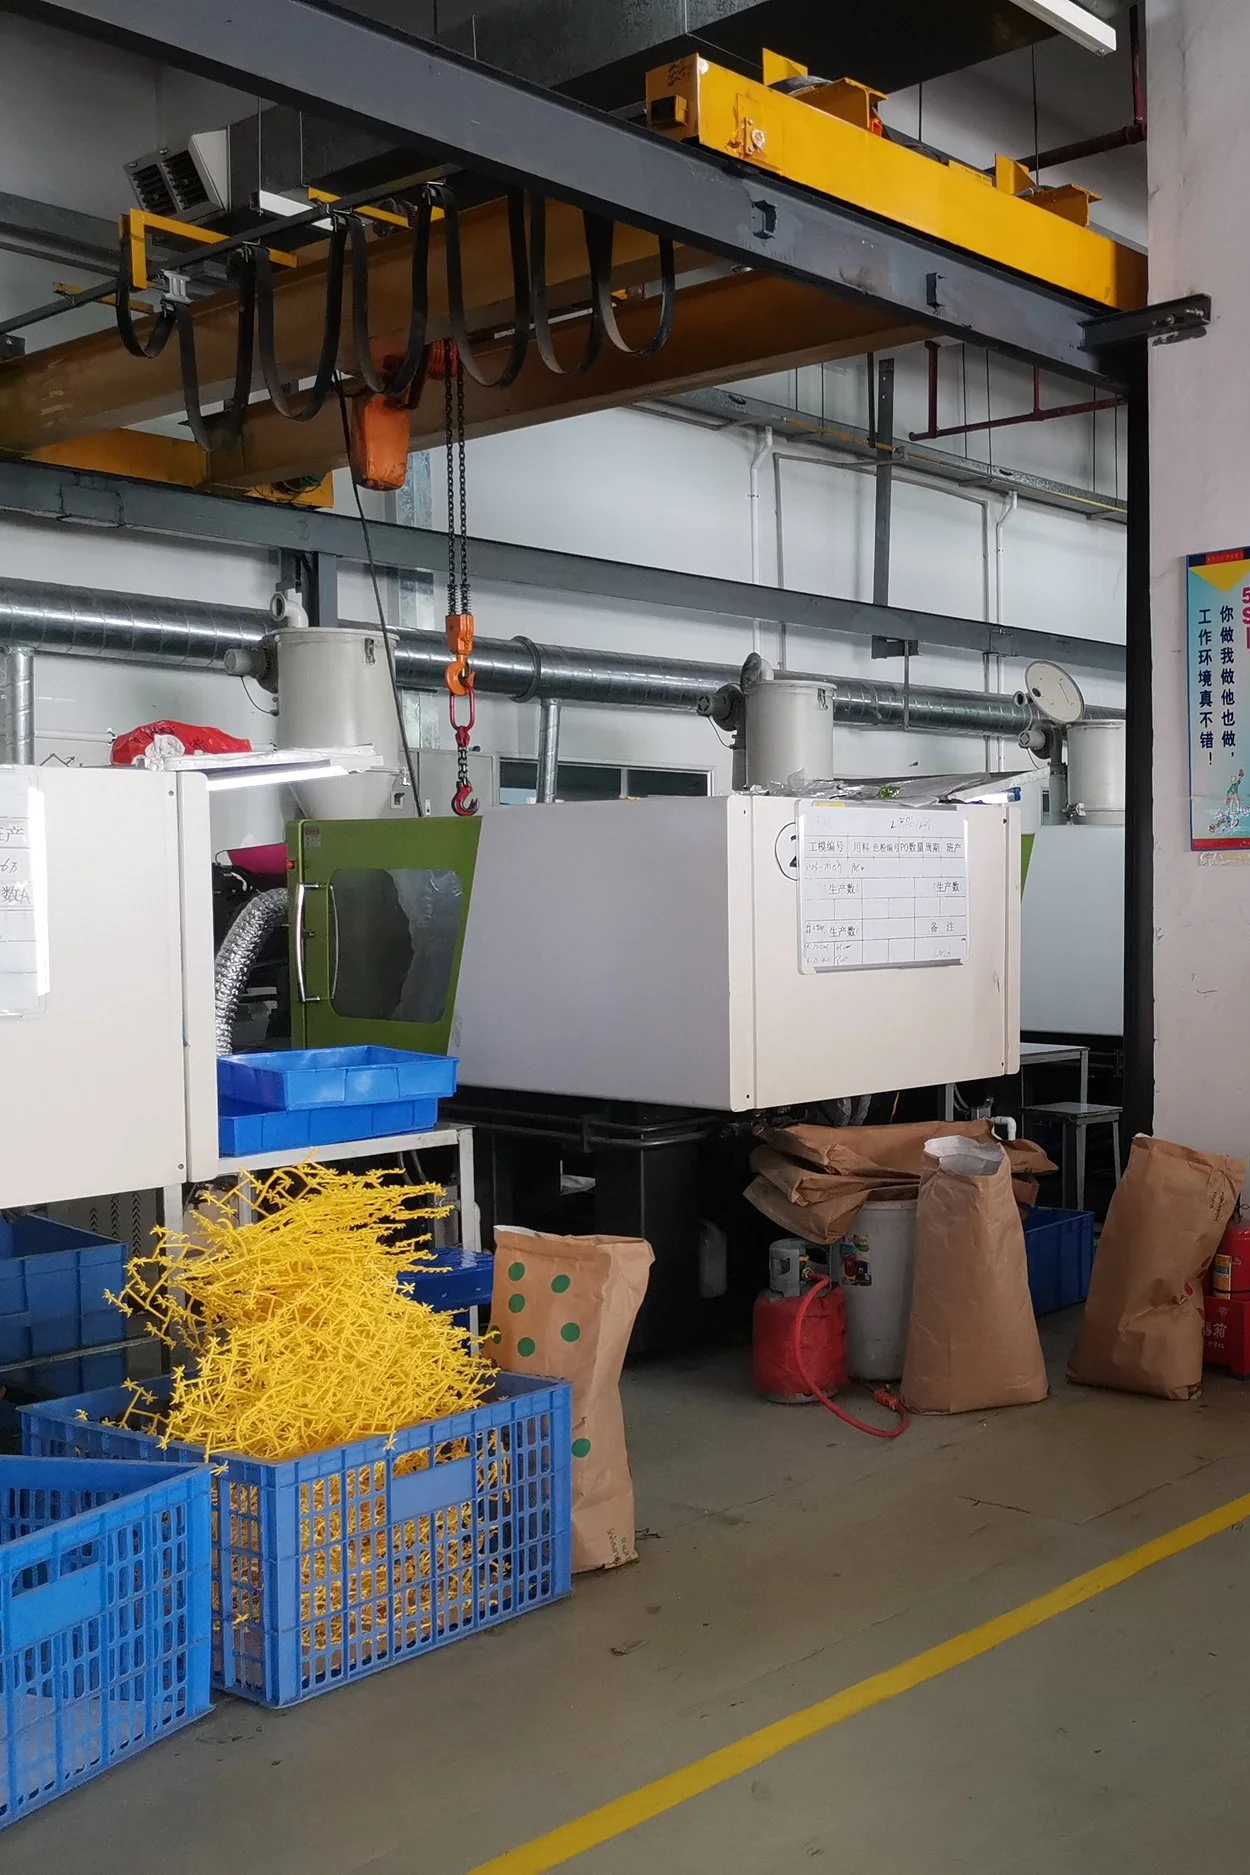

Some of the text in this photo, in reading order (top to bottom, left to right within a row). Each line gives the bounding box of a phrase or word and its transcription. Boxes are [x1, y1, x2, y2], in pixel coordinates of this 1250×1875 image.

[1198, 609, 1214, 765] 工作环境真不错！
[1220, 605, 1236, 759] 你做我做他也做，
